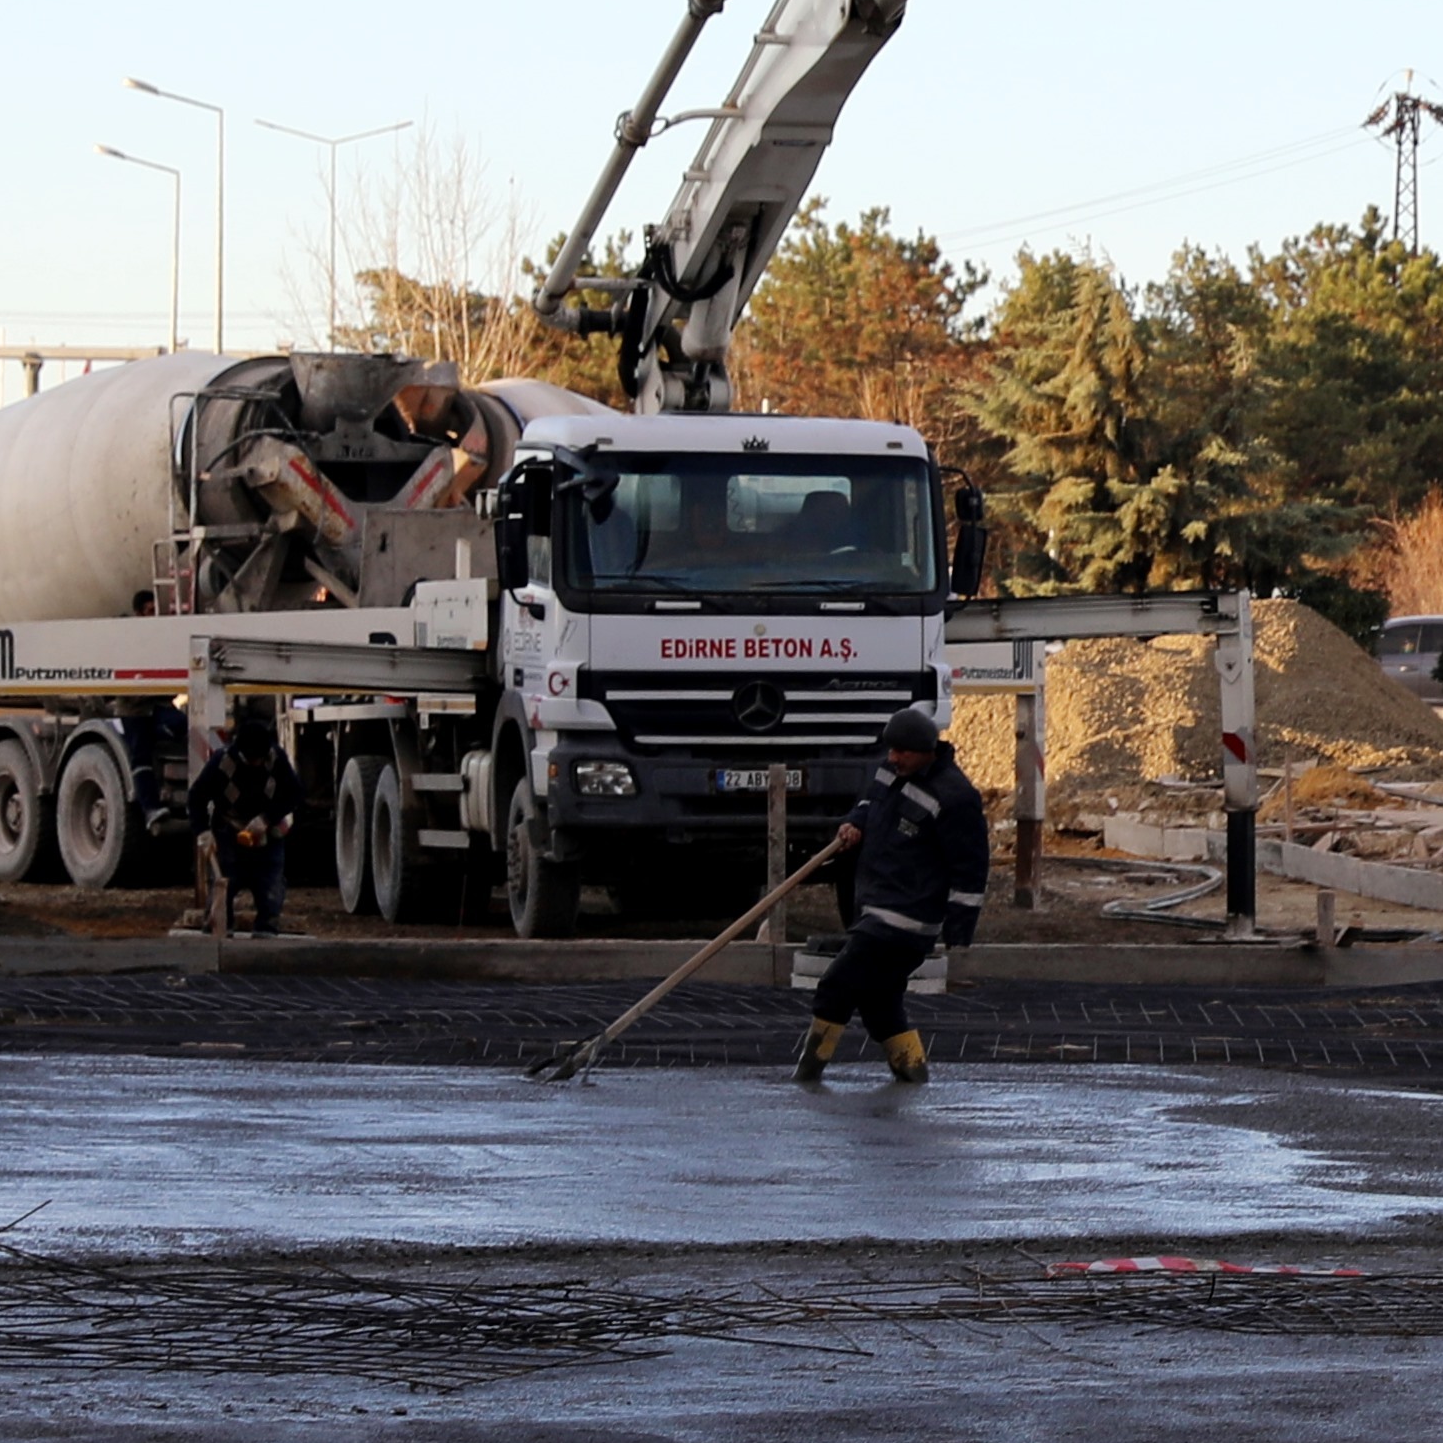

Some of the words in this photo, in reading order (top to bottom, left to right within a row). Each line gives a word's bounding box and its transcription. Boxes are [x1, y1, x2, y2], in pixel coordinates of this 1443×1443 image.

[744, 638, 812, 658] BETON
[820, 638, 858, 662] A.Ş.
[15, 668, 113, 680] Putzmeister
[726, 771, 741, 787] 22
